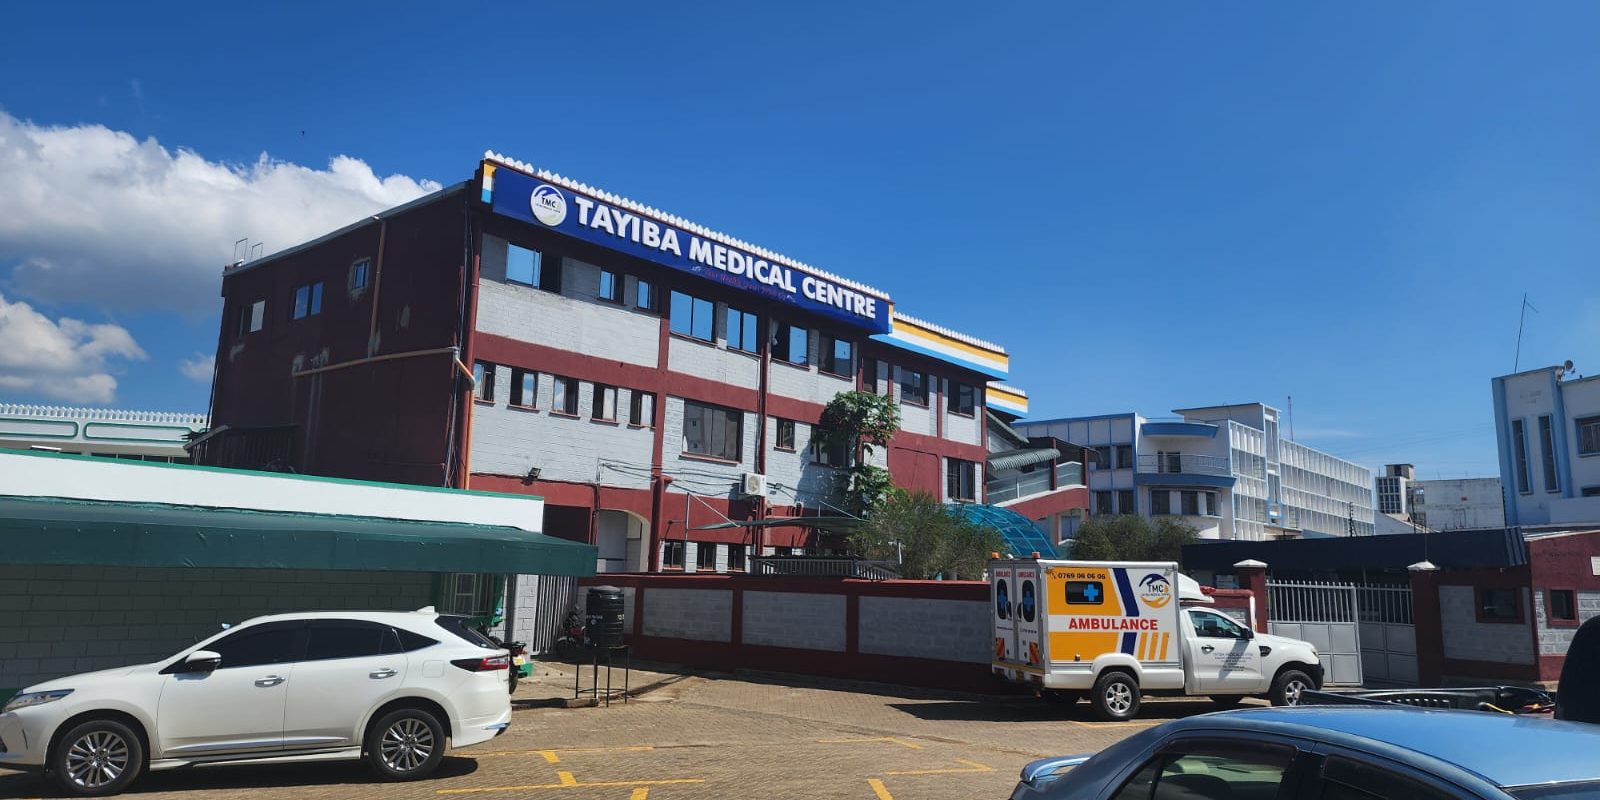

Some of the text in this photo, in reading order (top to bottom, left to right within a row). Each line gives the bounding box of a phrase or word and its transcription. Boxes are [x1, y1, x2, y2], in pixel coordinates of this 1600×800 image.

[541, 196, 556, 208] TMC
[575, 196, 682, 256] TAYIBA
[688, 237, 797, 293] MEDICAL
[802, 276, 876, 319] CENTRE
[1148, 584, 1164, 593] TMC
[1068, 618, 1159, 630] AMBULANCE
